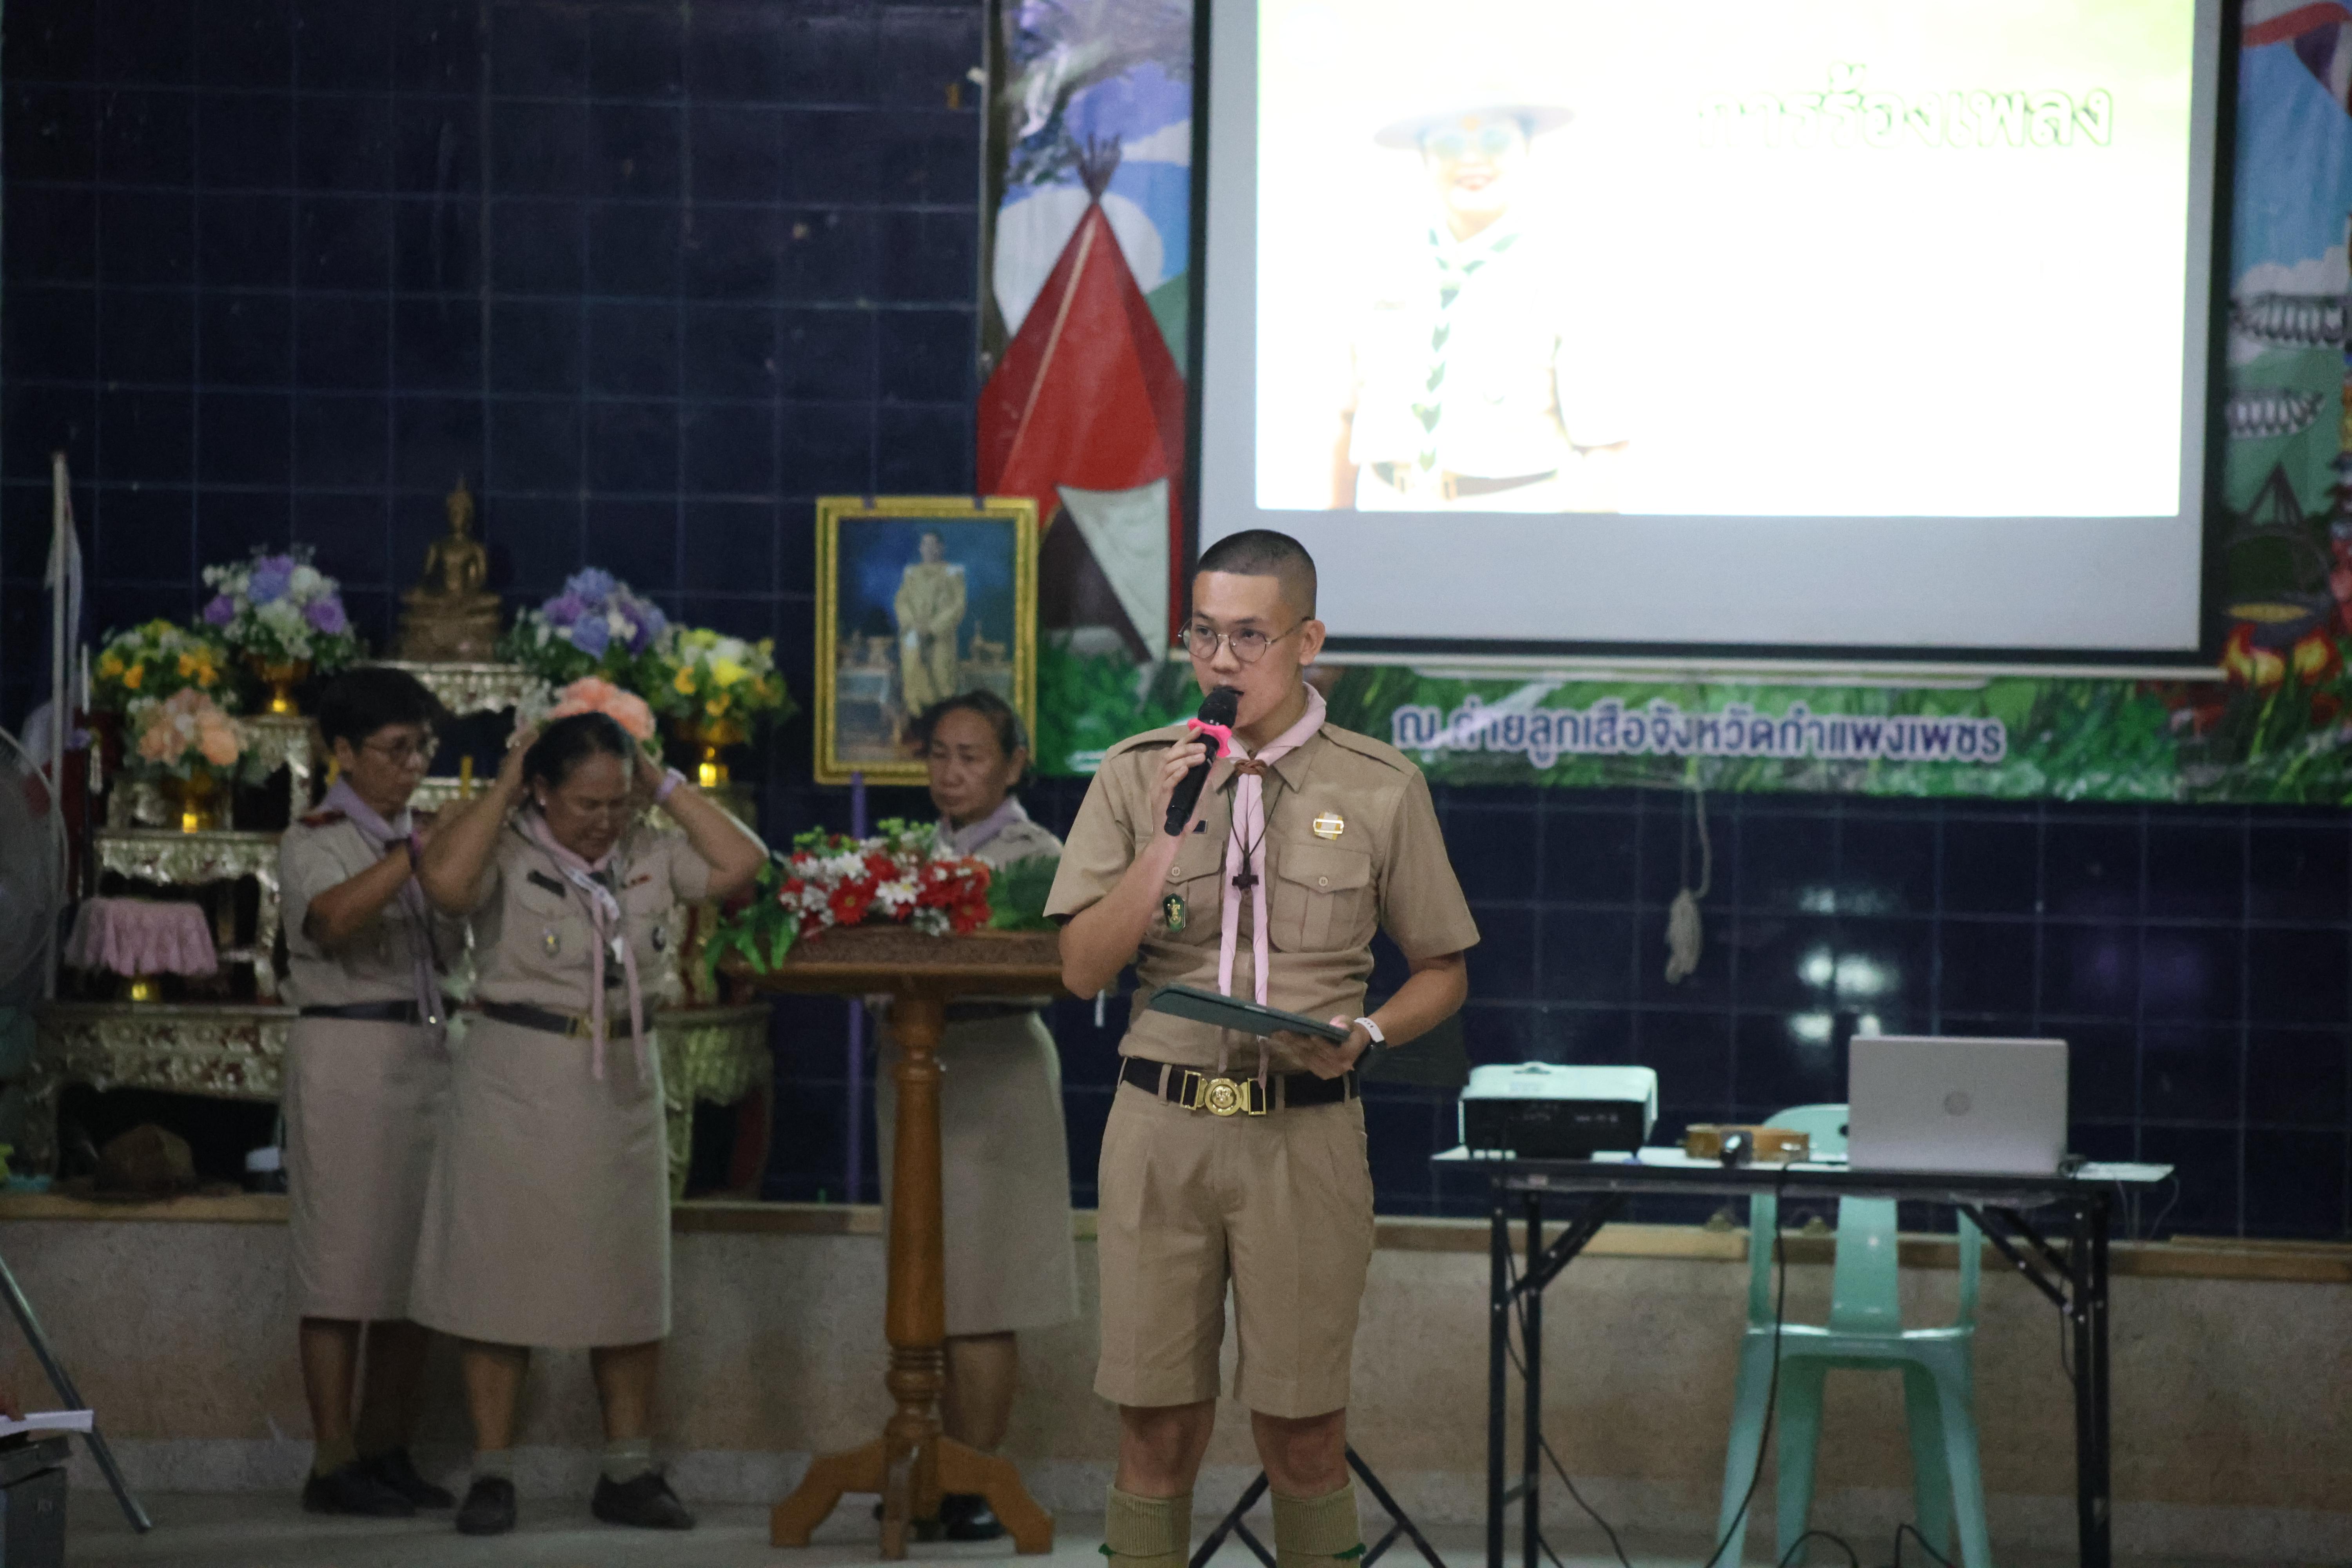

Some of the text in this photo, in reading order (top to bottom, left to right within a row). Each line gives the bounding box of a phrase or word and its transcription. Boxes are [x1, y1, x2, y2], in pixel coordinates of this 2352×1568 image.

[1698, 60, 2114, 148] การร้องเพลง
